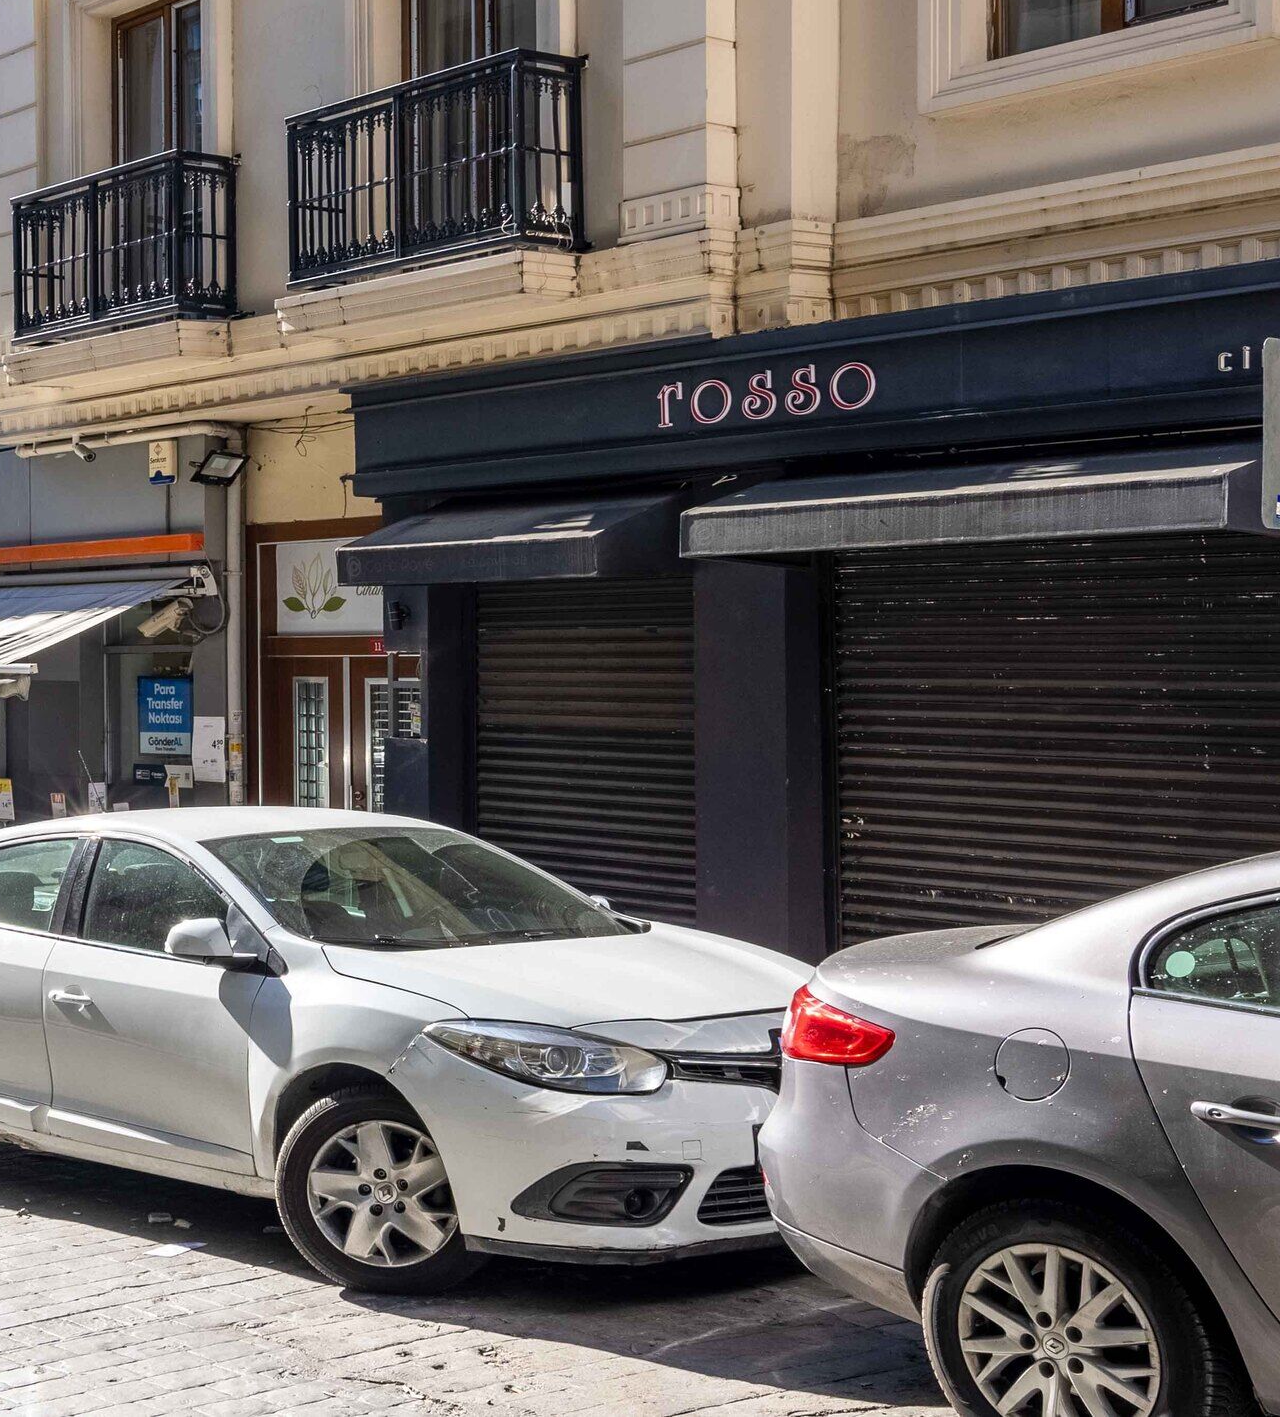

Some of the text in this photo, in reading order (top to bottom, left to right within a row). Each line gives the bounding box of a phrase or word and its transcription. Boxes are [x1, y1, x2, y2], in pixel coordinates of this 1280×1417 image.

[154, 683, 175, 695] Para
[147, 698, 183, 710] Transfer
[148, 712, 182, 724] Noktası
[148, 736, 183, 747] GönderAL
